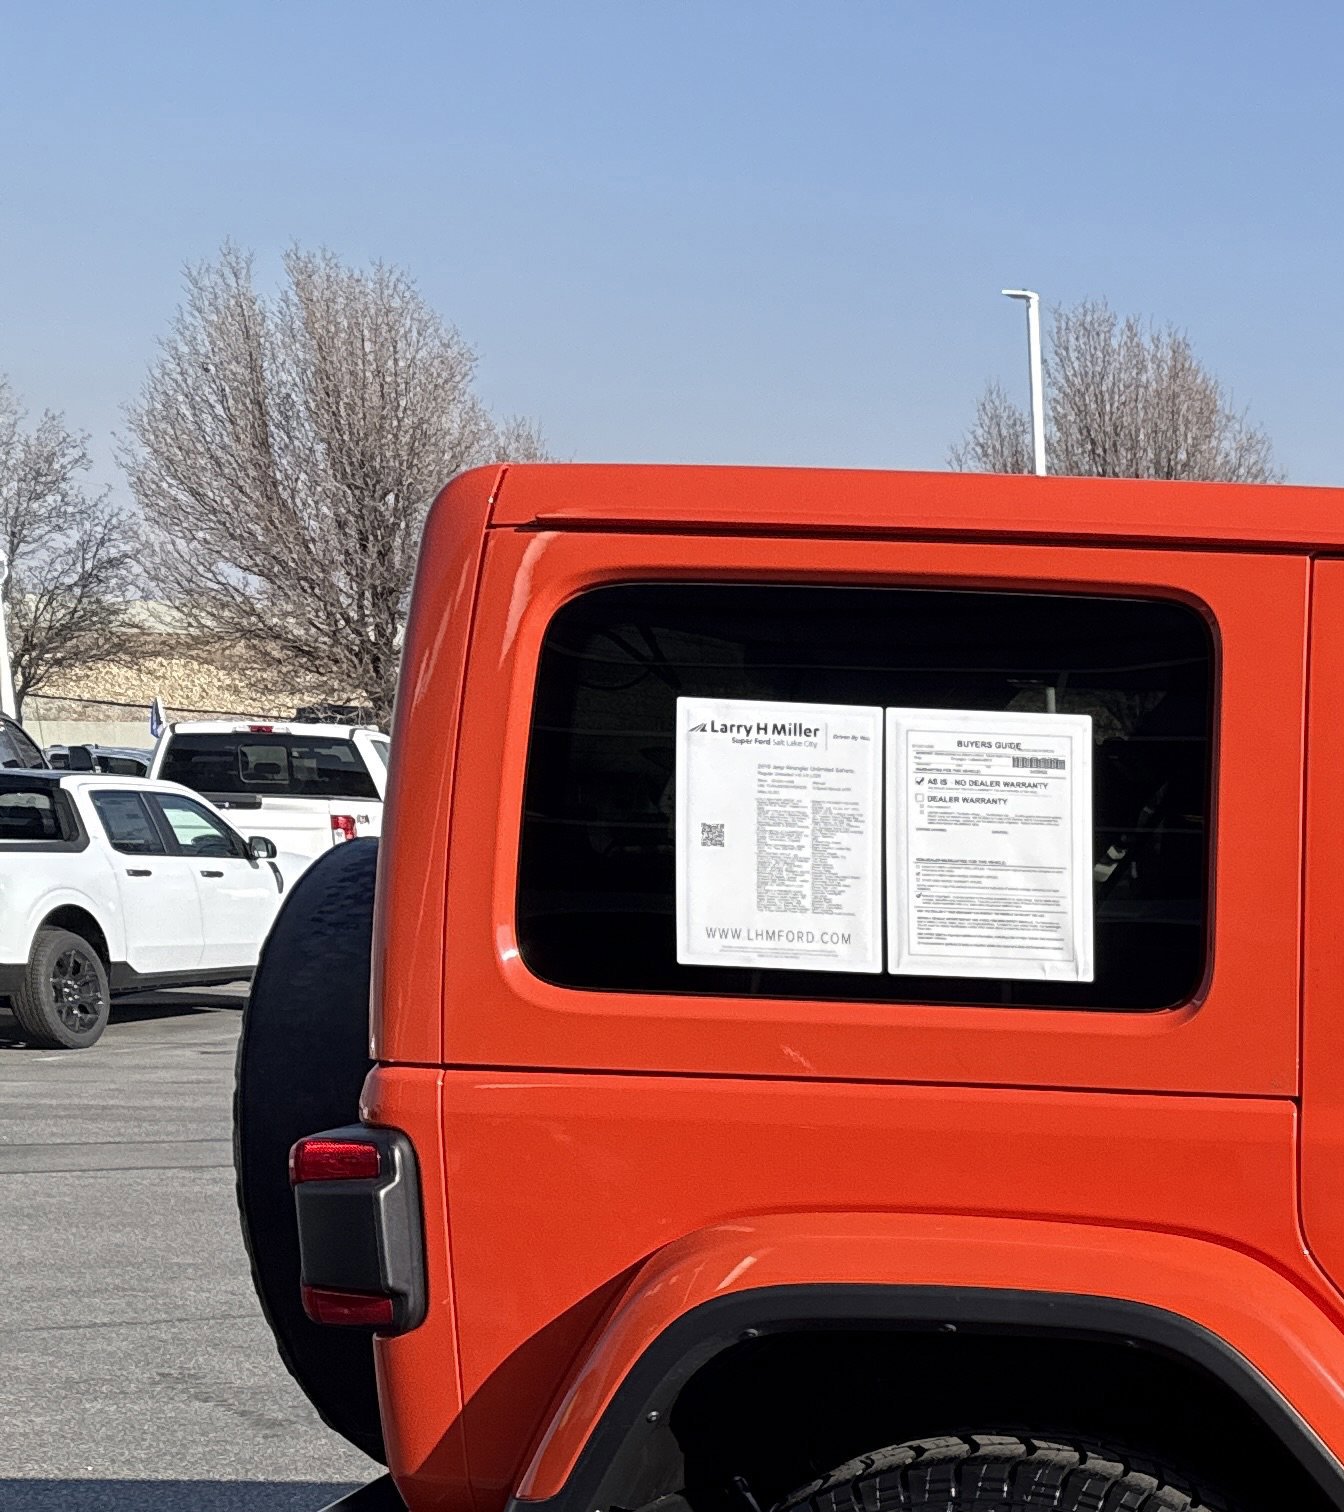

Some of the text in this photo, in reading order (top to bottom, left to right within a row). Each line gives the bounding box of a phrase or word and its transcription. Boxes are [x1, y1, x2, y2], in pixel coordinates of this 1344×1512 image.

[711, 720, 820, 738] Larry H Miller
[732, 737, 753, 745] Super
[754, 738, 771, 746] Ford
[773, 739, 786, 747] Salt
[804, 740, 818, 749] City
[957, 740, 993, 749] BUYERS
[995, 741, 1022, 750] GUIDE
[969, 780, 1001, 788] DEALER
[1003, 781, 1049, 790] WARRANTY
[927, 796, 1009, 805] DEALER WARRANTY
[705, 926, 852, 945] WWW.LHMFORD.COM
